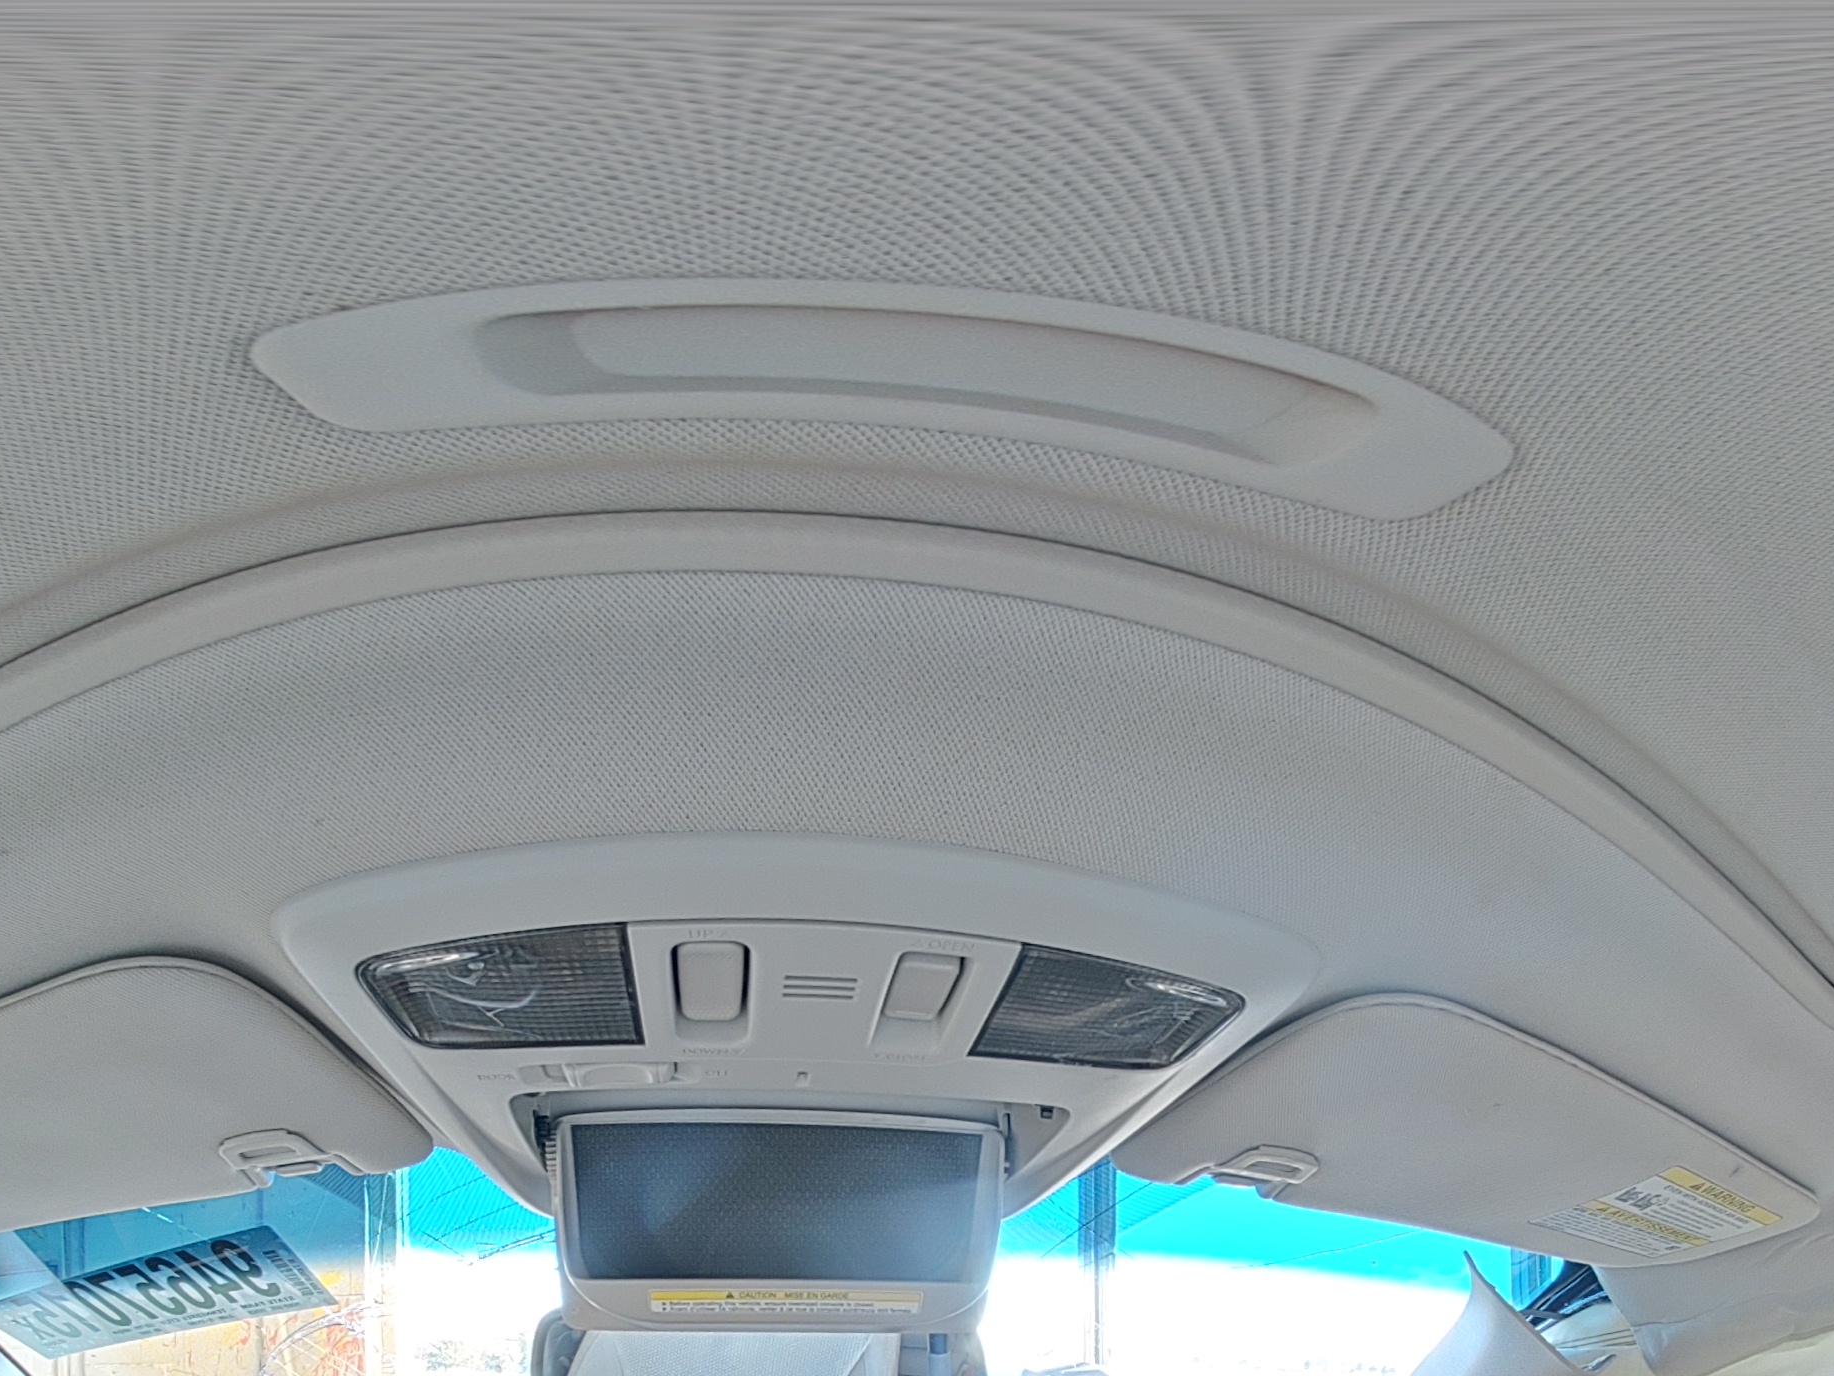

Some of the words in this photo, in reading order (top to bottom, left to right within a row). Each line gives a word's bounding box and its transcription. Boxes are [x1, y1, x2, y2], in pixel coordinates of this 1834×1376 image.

[928, 940, 974, 953] OPEN
[1700, 1182, 1756, 1213] WARNING
[738, 1291, 777, 1299] CAUTION
